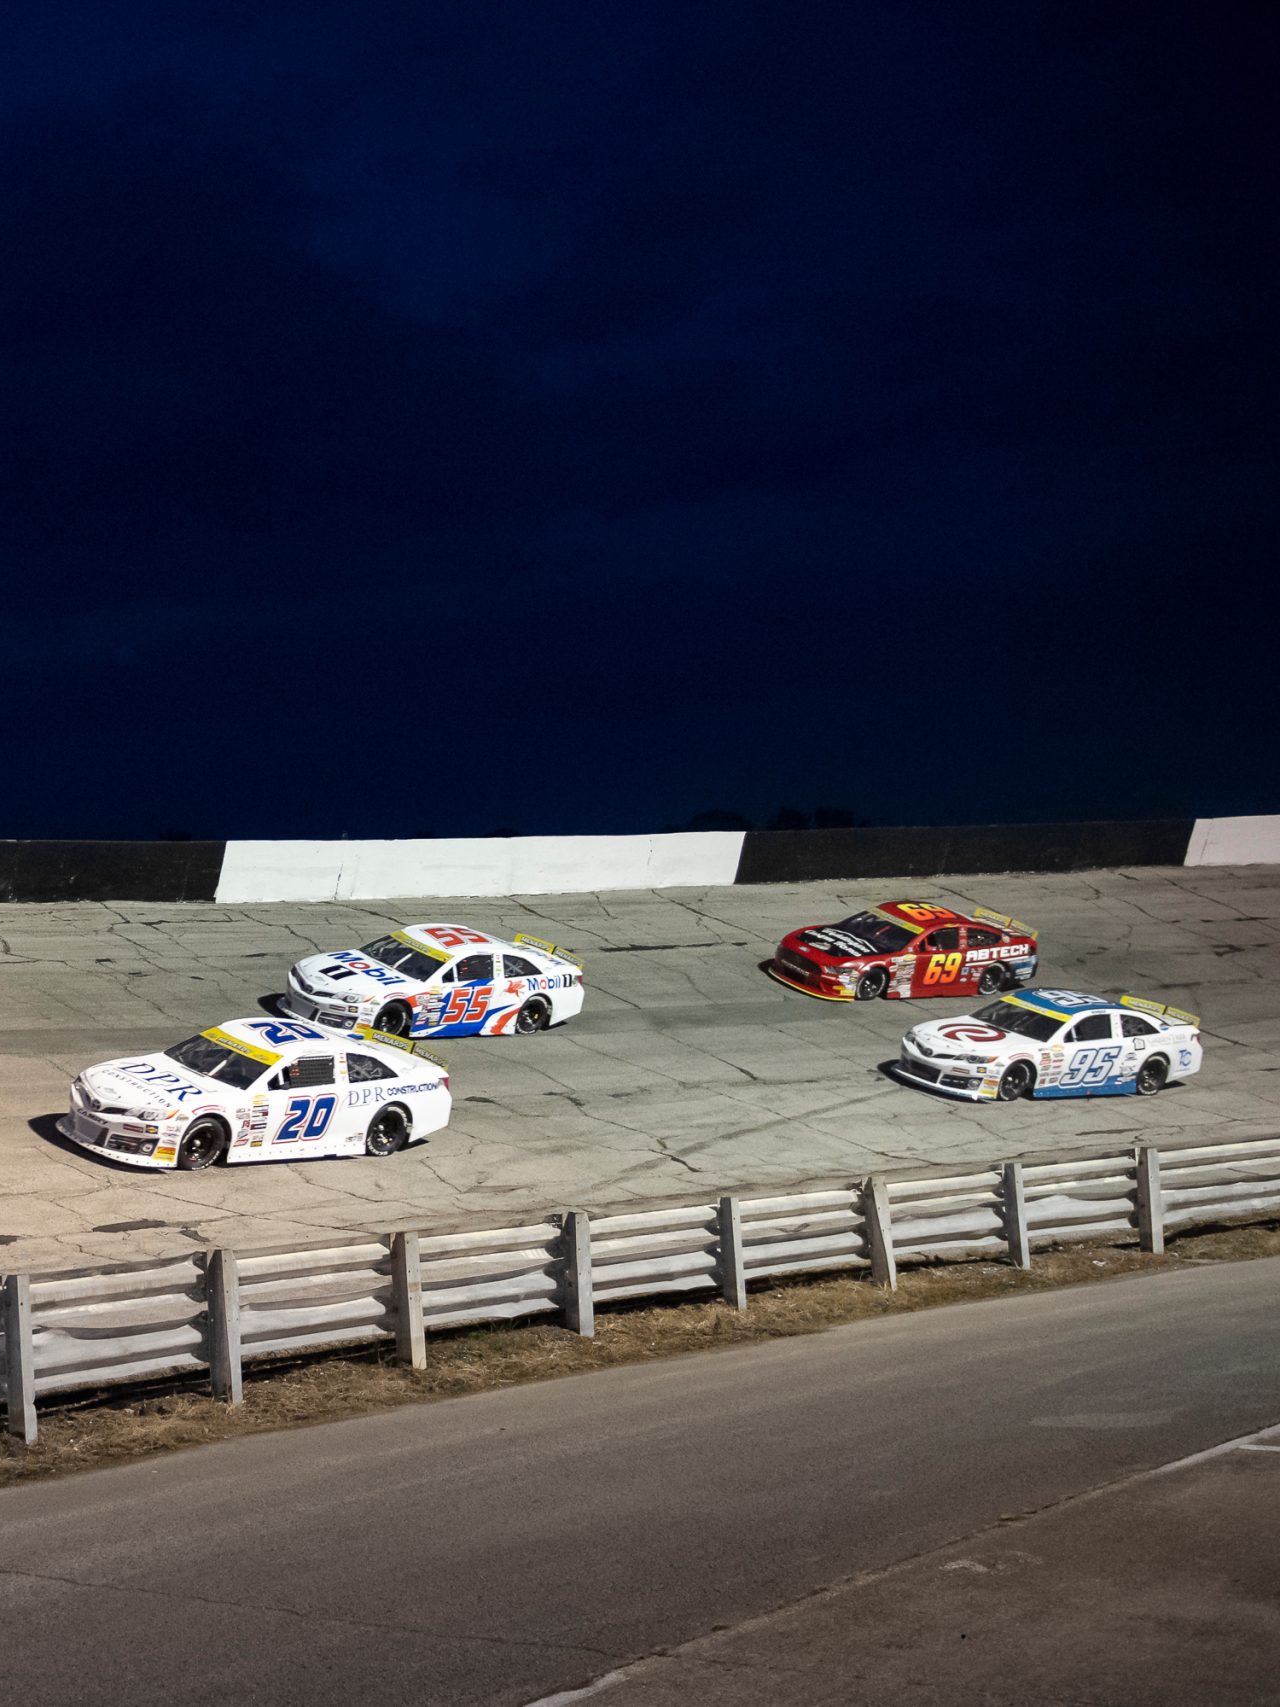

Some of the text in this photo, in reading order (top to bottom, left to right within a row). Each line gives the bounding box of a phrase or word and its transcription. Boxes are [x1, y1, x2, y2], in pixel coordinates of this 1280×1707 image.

[897, 903, 958, 920] 69
[424, 927, 492, 949] 55
[966, 944, 1030, 961] ABTECH
[327, 952, 407, 985] Mobil
[923, 952, 962, 985] 69
[526, 974, 573, 991] Mobil 1
[440, 986, 495, 1025] 55
[1034, 989, 1113, 1007] 95
[243, 1021, 328, 1048] 20
[373, 1032, 409, 1051] MENARDS
[1060, 1046, 1122, 1088] 95
[102, 1068, 173, 1108] CONSTRUCTION
[119, 1063, 202, 1101] DPR
[348, 1082, 441, 1106] DPR CONSTRUCTION
[273, 1093, 338, 1144] 20
